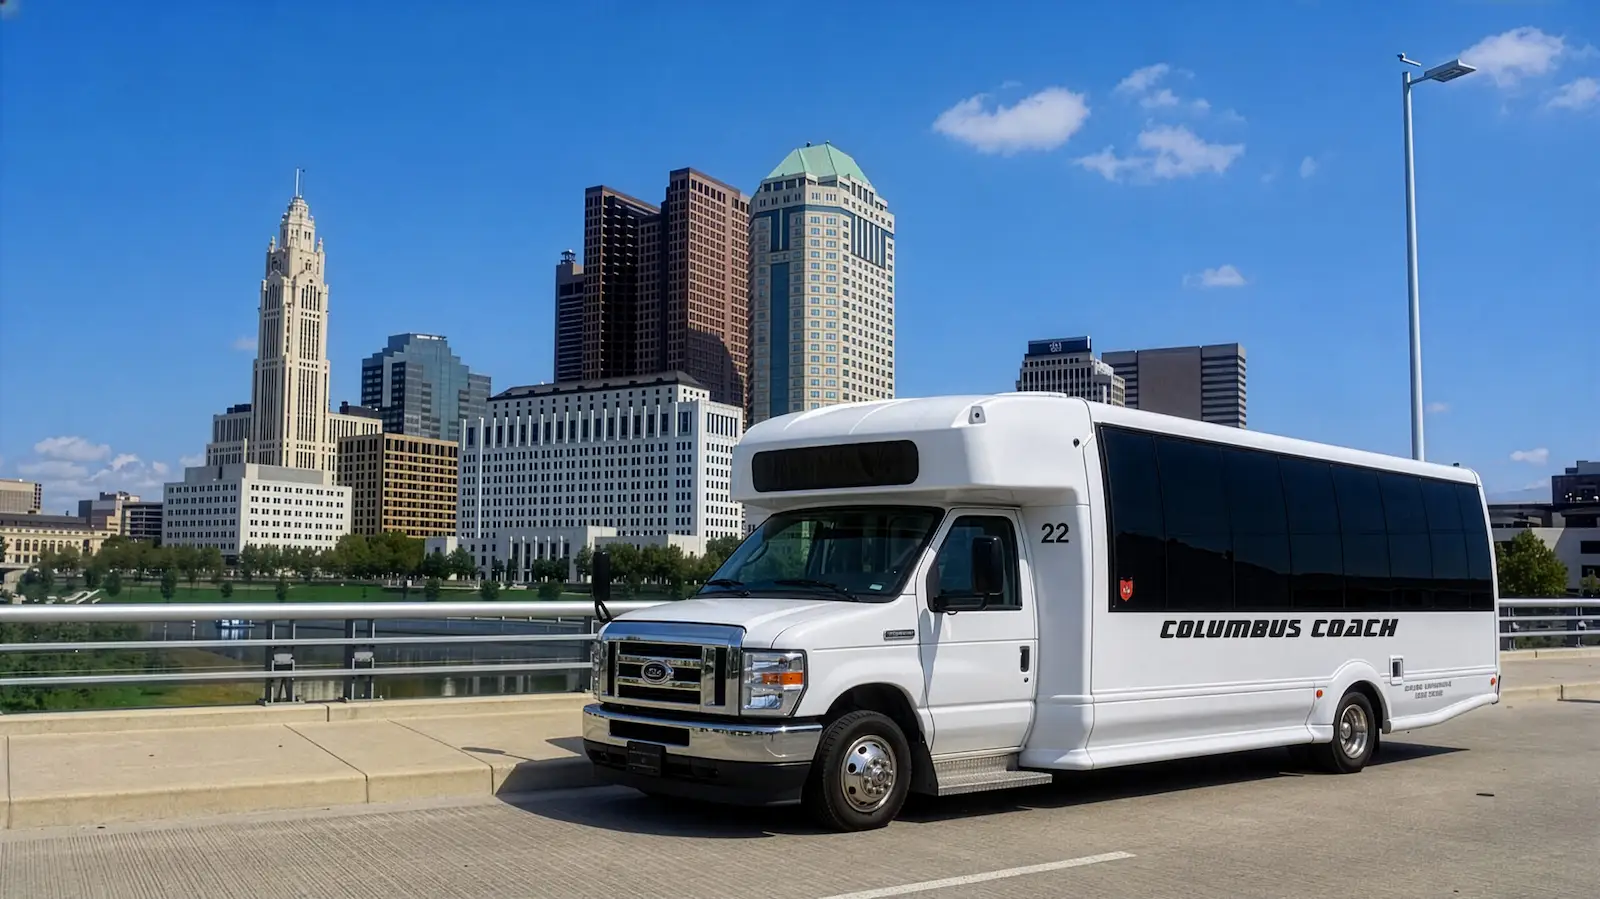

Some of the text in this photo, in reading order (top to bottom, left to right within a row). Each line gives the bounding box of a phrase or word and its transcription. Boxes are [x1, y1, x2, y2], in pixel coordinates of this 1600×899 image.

[1041, 523, 1069, 544] 22
[1159, 618, 1399, 638] COLUMBUS COACH
